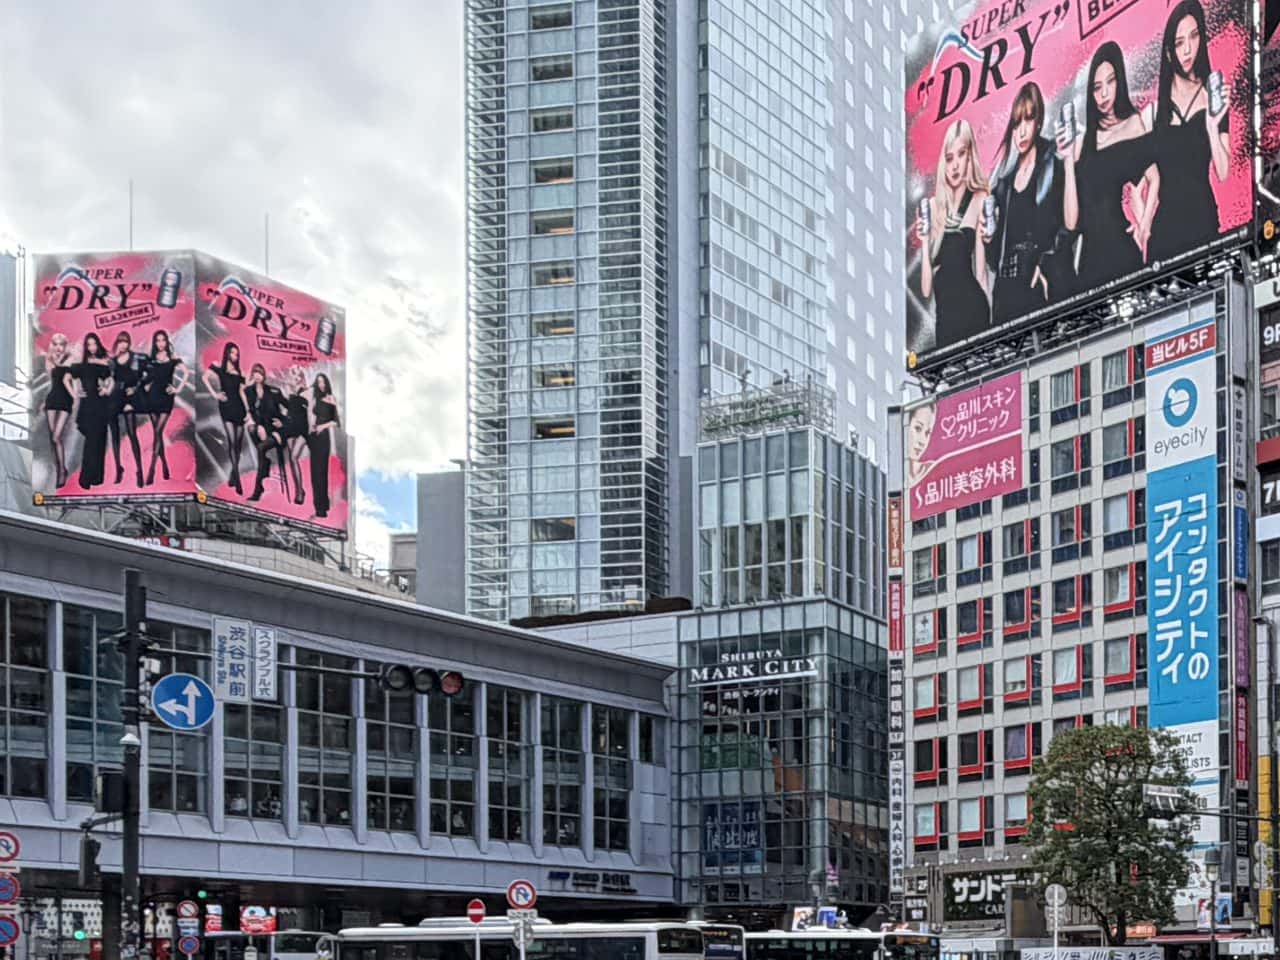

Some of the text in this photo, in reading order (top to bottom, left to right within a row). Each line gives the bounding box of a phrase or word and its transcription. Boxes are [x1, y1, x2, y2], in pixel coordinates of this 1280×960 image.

[960, 0, 1025, 48] SUPER
[1151, 329, 1208, 364] 当ビル5F
[956, 386, 1016, 420] 品川スキン
[957, 408, 1009, 442] クリニック
[1154, 426, 1208, 456] eyecity
[925, 456, 1016, 506] 品川美容外科
[1154, 500, 1184, 684] アイシティ
[1188, 493, 1209, 680] コンタクトの
[229, 626, 247, 697] 渋谷駅前
[691, 658, 817, 682] MARK CITY
[721, 649, 783, 663] SHIBUYA
